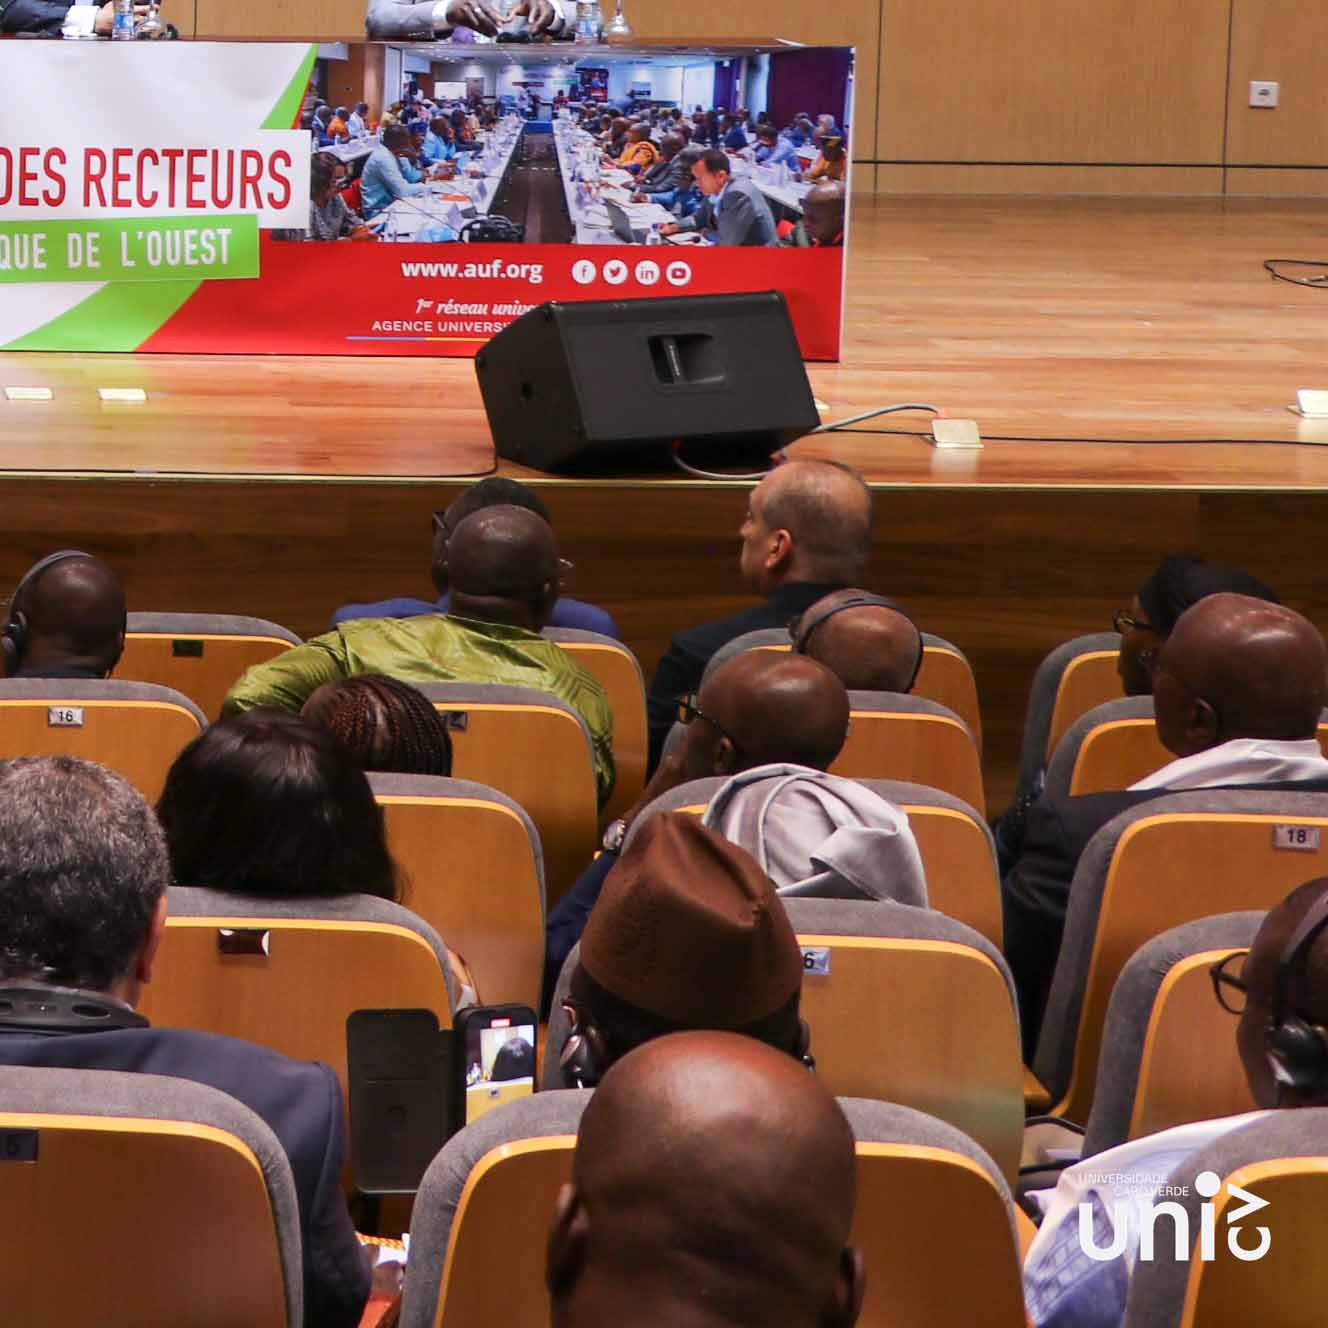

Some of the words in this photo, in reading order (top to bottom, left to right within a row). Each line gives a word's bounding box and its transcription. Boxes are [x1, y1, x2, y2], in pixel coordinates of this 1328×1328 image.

[83, 147, 292, 210] RECTEURS
[66, 231, 101, 269] DE
[121, 228, 232, 269] L'OUEST
[401, 258, 543, 284] www.auf.org
[437, 298, 488, 316] réseau
[372, 320, 432, 332] AGENCE
[58, 710, 73, 723] 16
[1287, 829, 1306, 844] 18
[804, 952, 814, 969] 6
